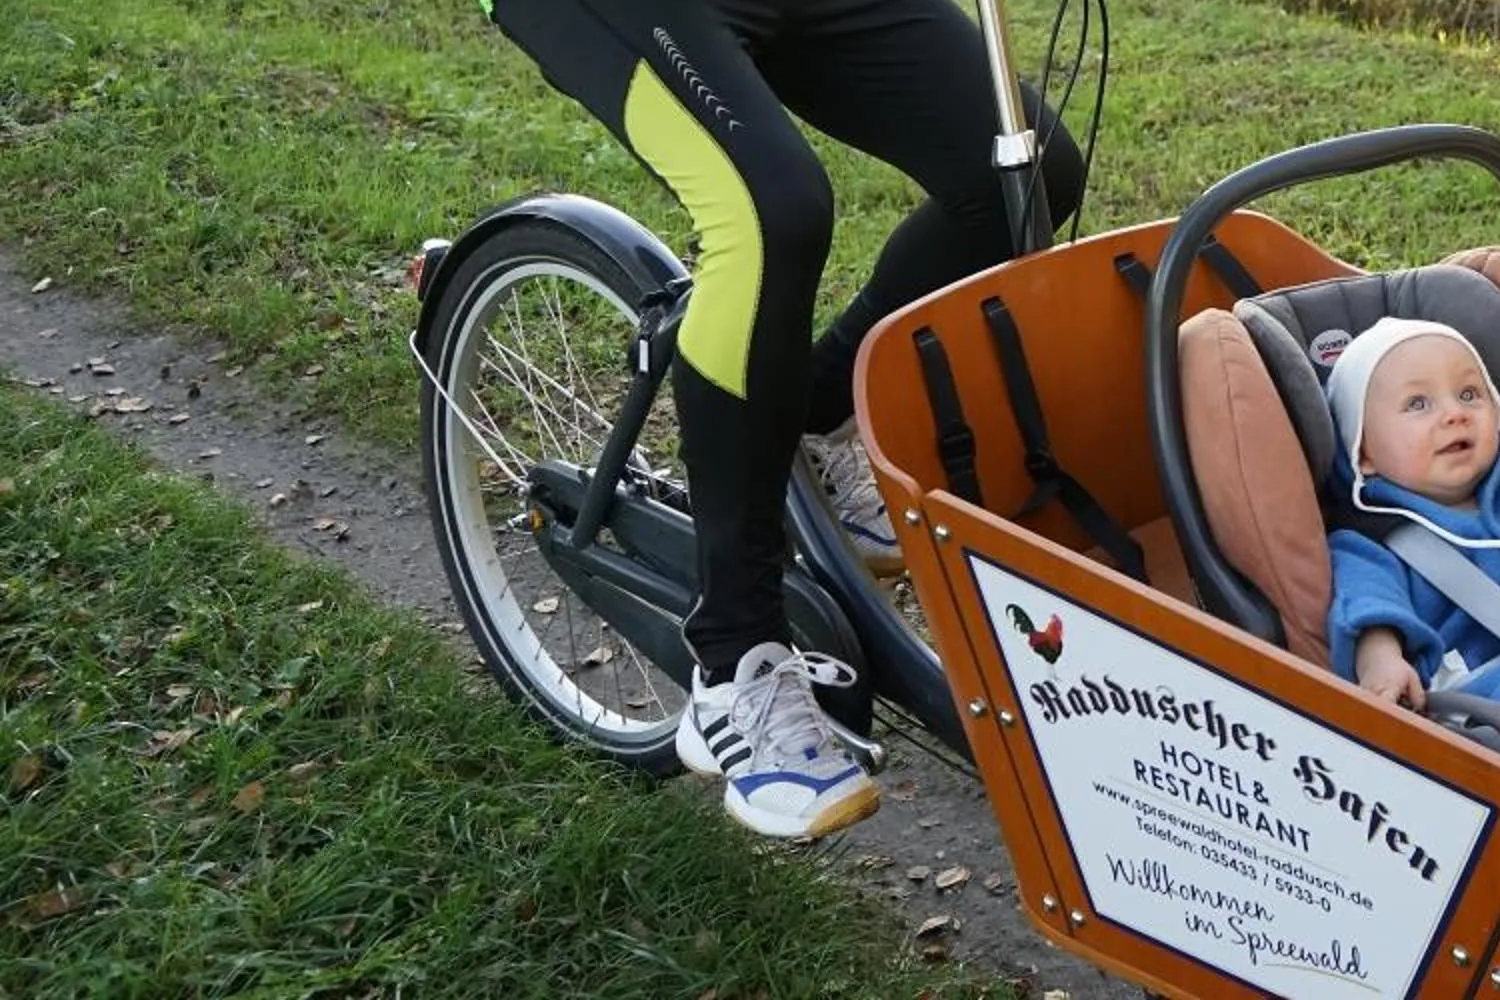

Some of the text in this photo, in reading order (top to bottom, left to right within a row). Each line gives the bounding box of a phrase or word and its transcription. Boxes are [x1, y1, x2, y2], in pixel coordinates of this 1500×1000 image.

[1029, 674, 1440, 882] Radduscher Hafen
[1132, 758, 1313, 853] RESTAURANT
[1091, 780, 1374, 911] www.spreewaldhotel-raddusch.de
[1104, 851, 1276, 923] Willkommen
[1135, 815, 1198, 855] Telefon:
[1200, 844, 1258, 881] 035433
[1274, 876, 1332, 914] 5933-0
[1184, 910, 1369, 980] im Spreewald
